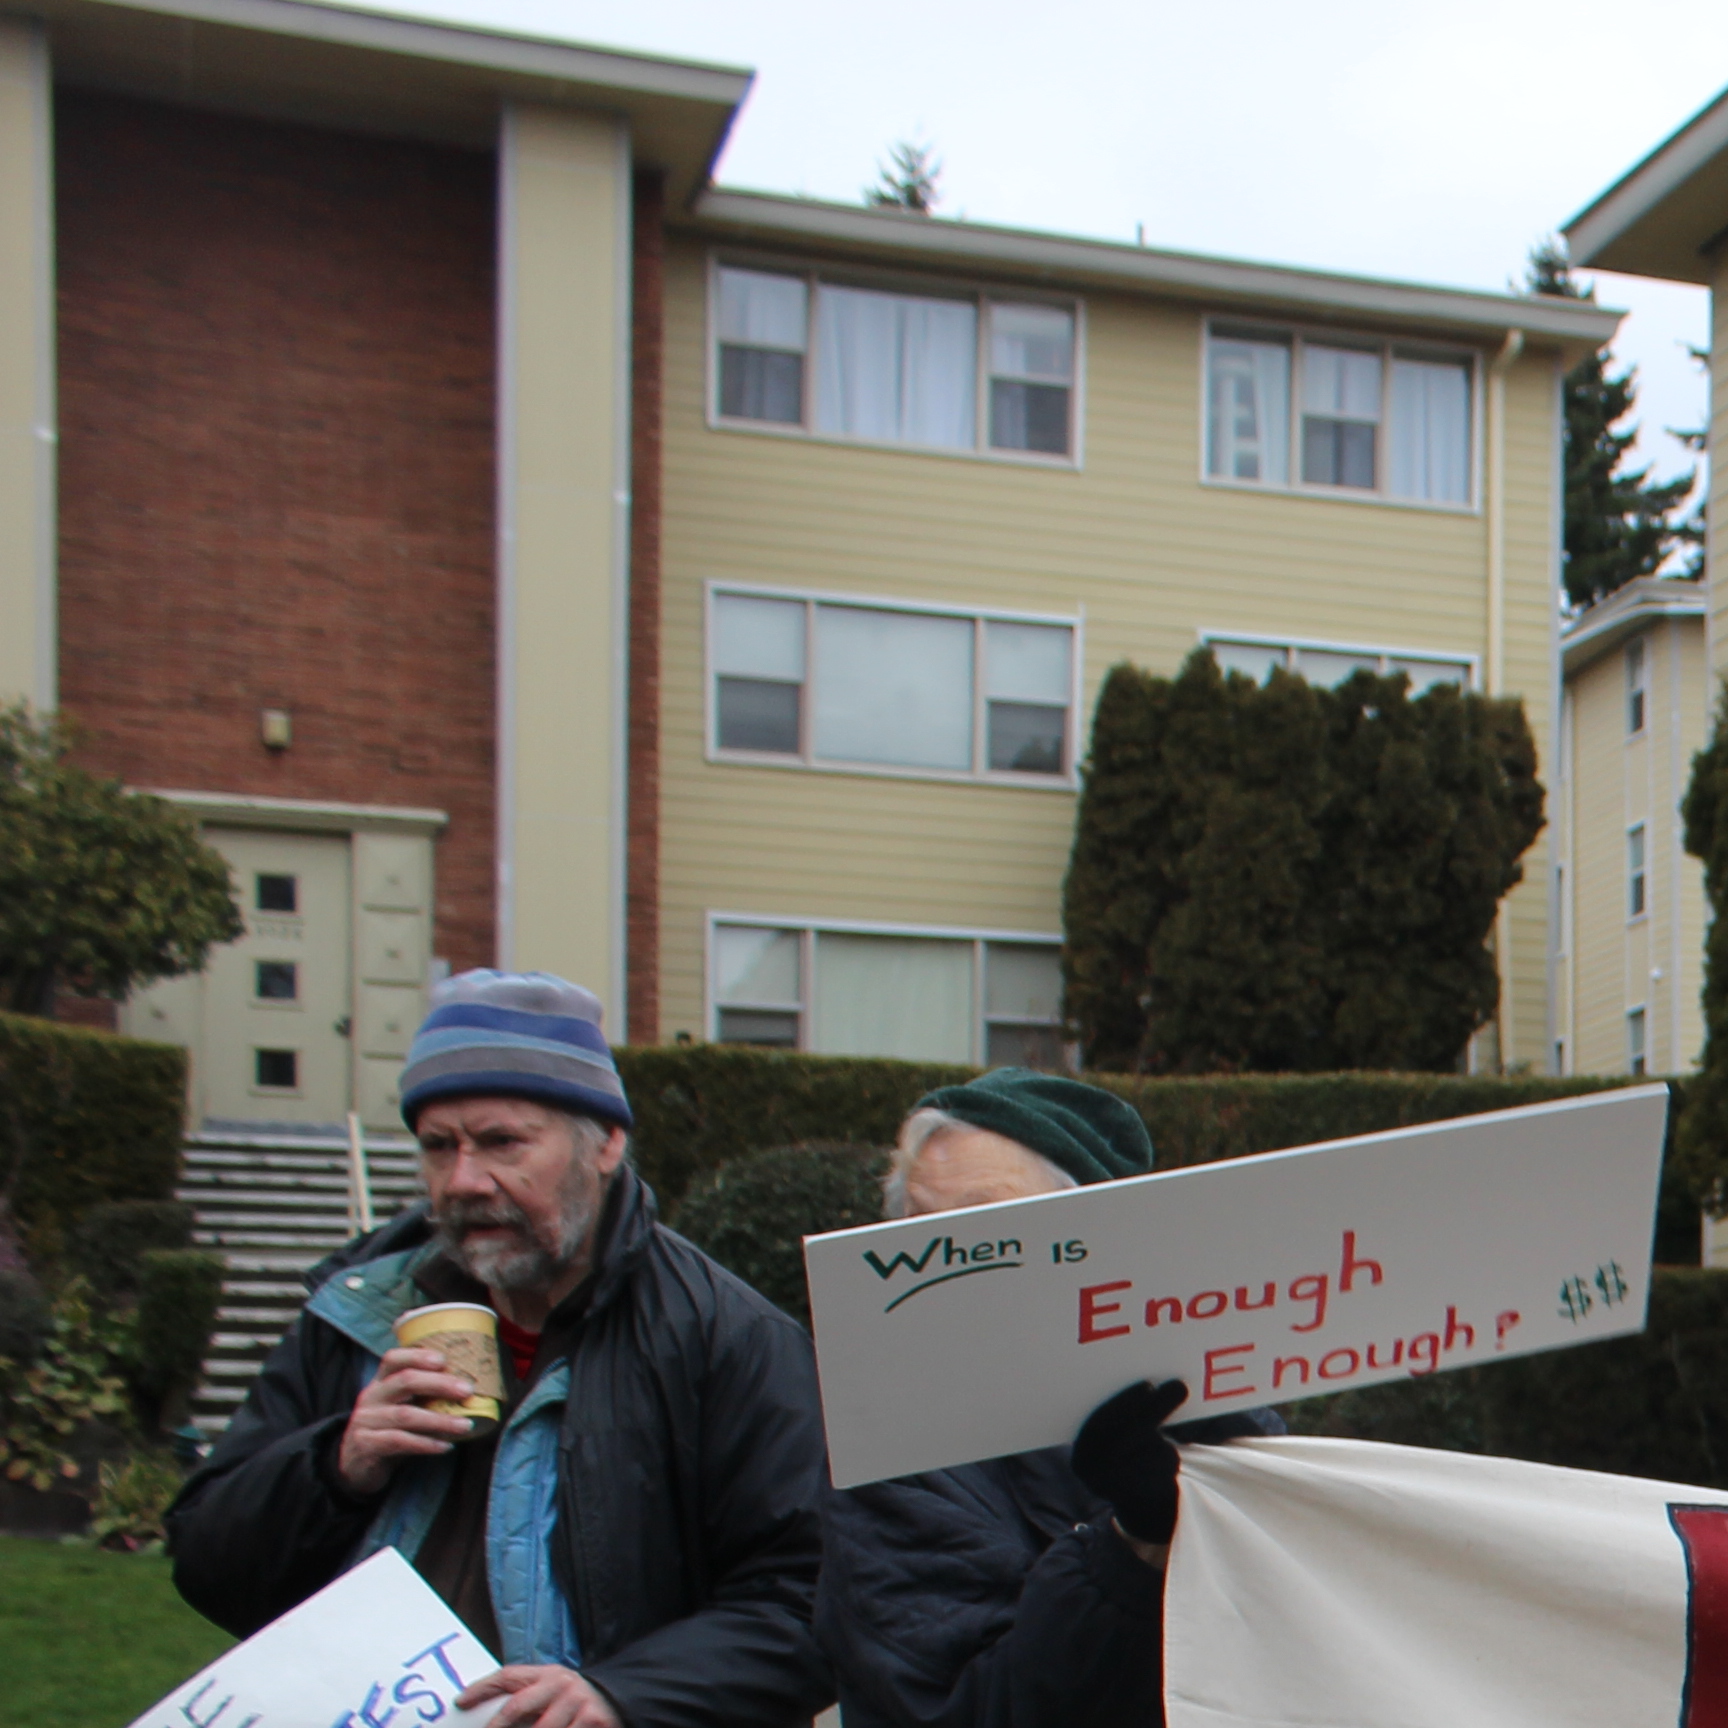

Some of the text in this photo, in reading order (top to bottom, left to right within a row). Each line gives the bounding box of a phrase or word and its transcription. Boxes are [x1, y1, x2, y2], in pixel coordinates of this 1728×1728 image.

[863, 1237, 1022, 1281] When
[1077, 1231, 1384, 1344] Enough
[1558, 1261, 1629, 1323] $$
